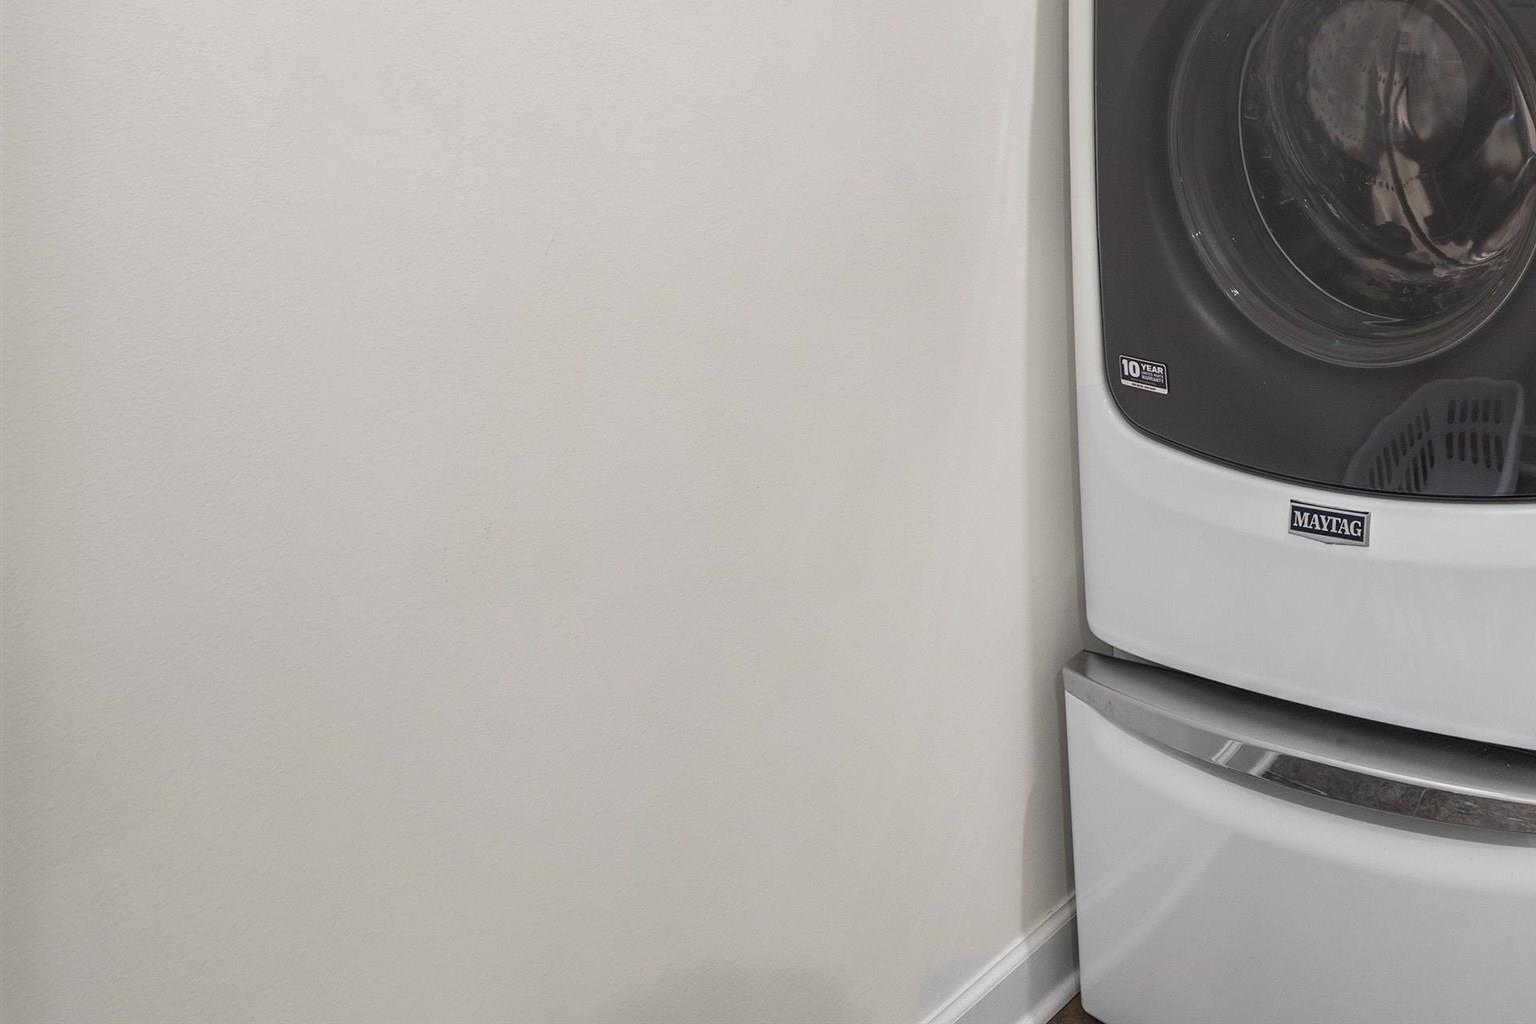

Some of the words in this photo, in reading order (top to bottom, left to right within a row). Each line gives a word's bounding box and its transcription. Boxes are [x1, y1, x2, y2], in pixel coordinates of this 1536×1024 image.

[1121, 359, 1140, 377] 10
[1141, 363, 1164, 375] YEAR
[1293, 510, 1362, 537] MAYTAG
